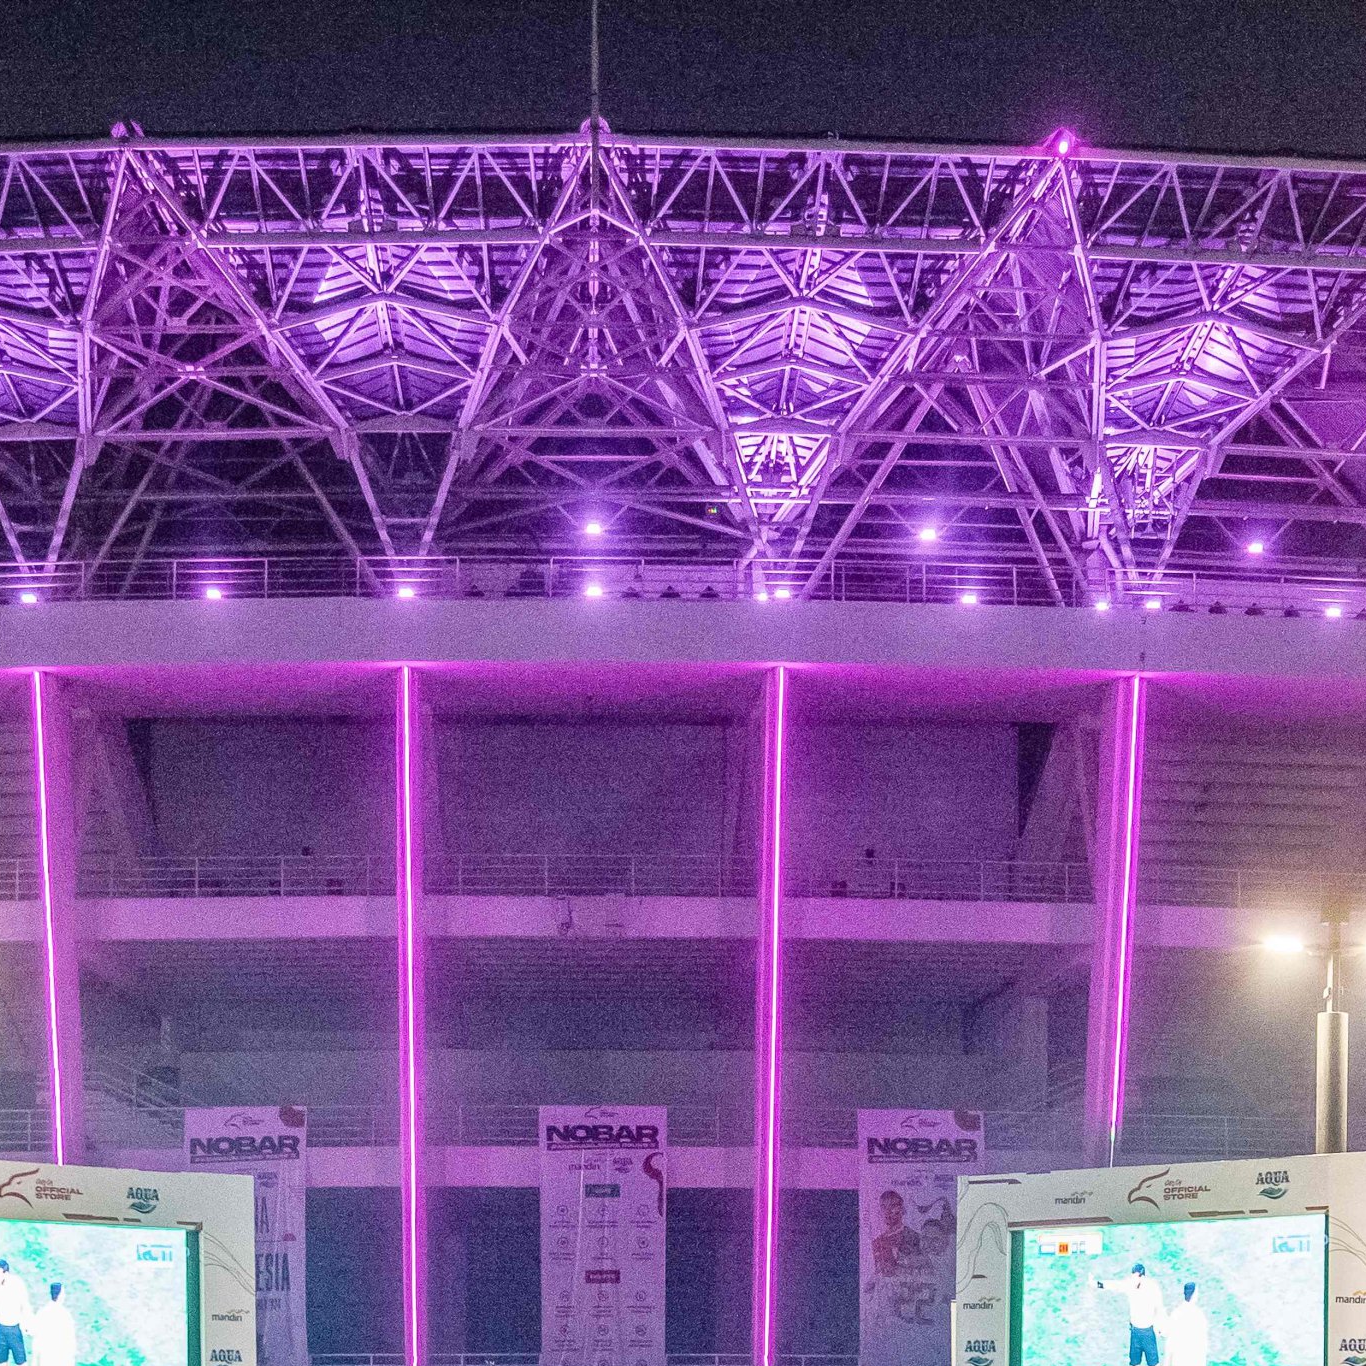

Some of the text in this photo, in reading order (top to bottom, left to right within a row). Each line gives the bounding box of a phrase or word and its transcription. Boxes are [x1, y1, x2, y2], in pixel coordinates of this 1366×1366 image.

[546, 1125, 659, 1142] NOBAR
[190, 1135, 300, 1156] NOBAR
[867, 1136, 977, 1156] NOBAR
[1255, 1170, 1290, 1187] AQUA
[35, 1185, 84, 1195] OFFICIAL
[35, 1192, 72, 1201] STORE
[126, 1186, 160, 1202] AQUA
[1163, 1184, 1211, 1194] OFFICIAL
[1163, 1192, 1199, 1201] STORE
[962, 1301, 993, 1310] mandiri
[965, 1339, 996, 1355] AQUA
[210, 1348, 243, 1364] AQUA
